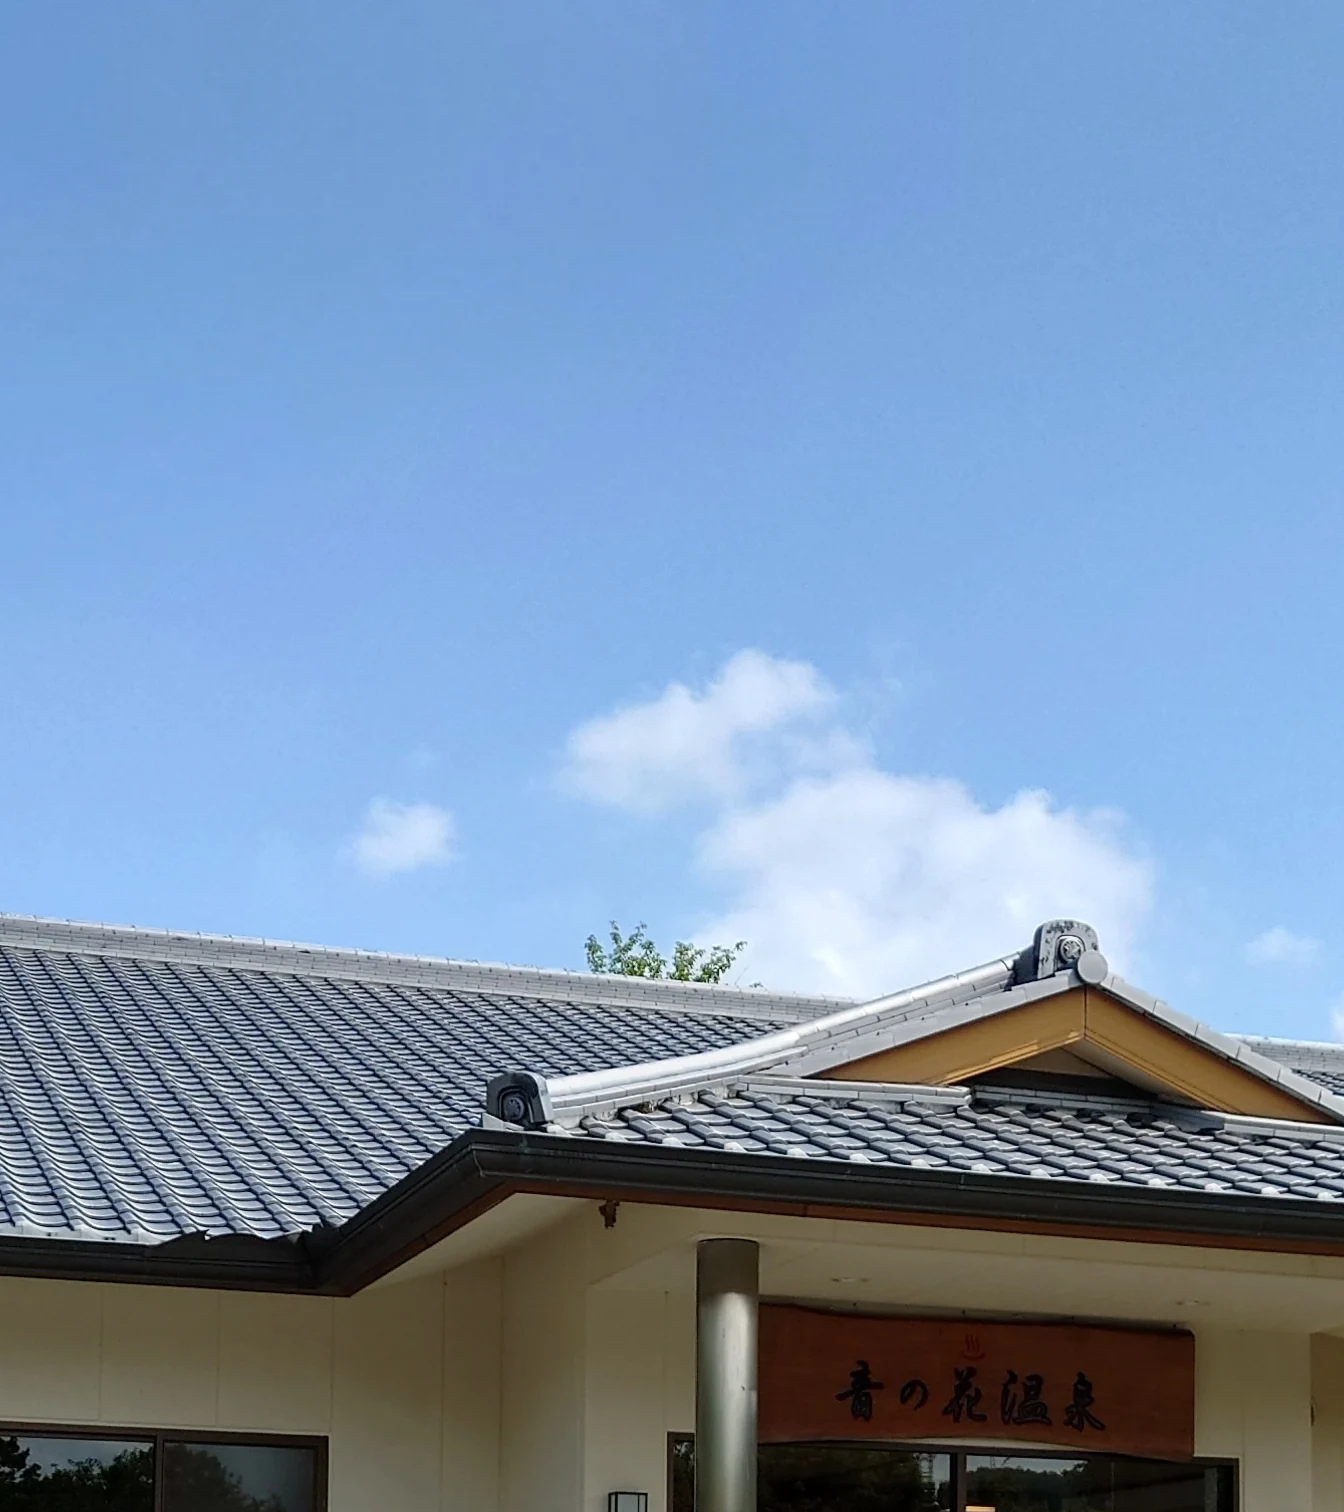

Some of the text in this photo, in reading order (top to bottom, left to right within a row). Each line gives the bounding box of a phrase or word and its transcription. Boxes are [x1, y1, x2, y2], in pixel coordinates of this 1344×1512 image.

[835, 1360, 1106, 1432] 音の花温泉
